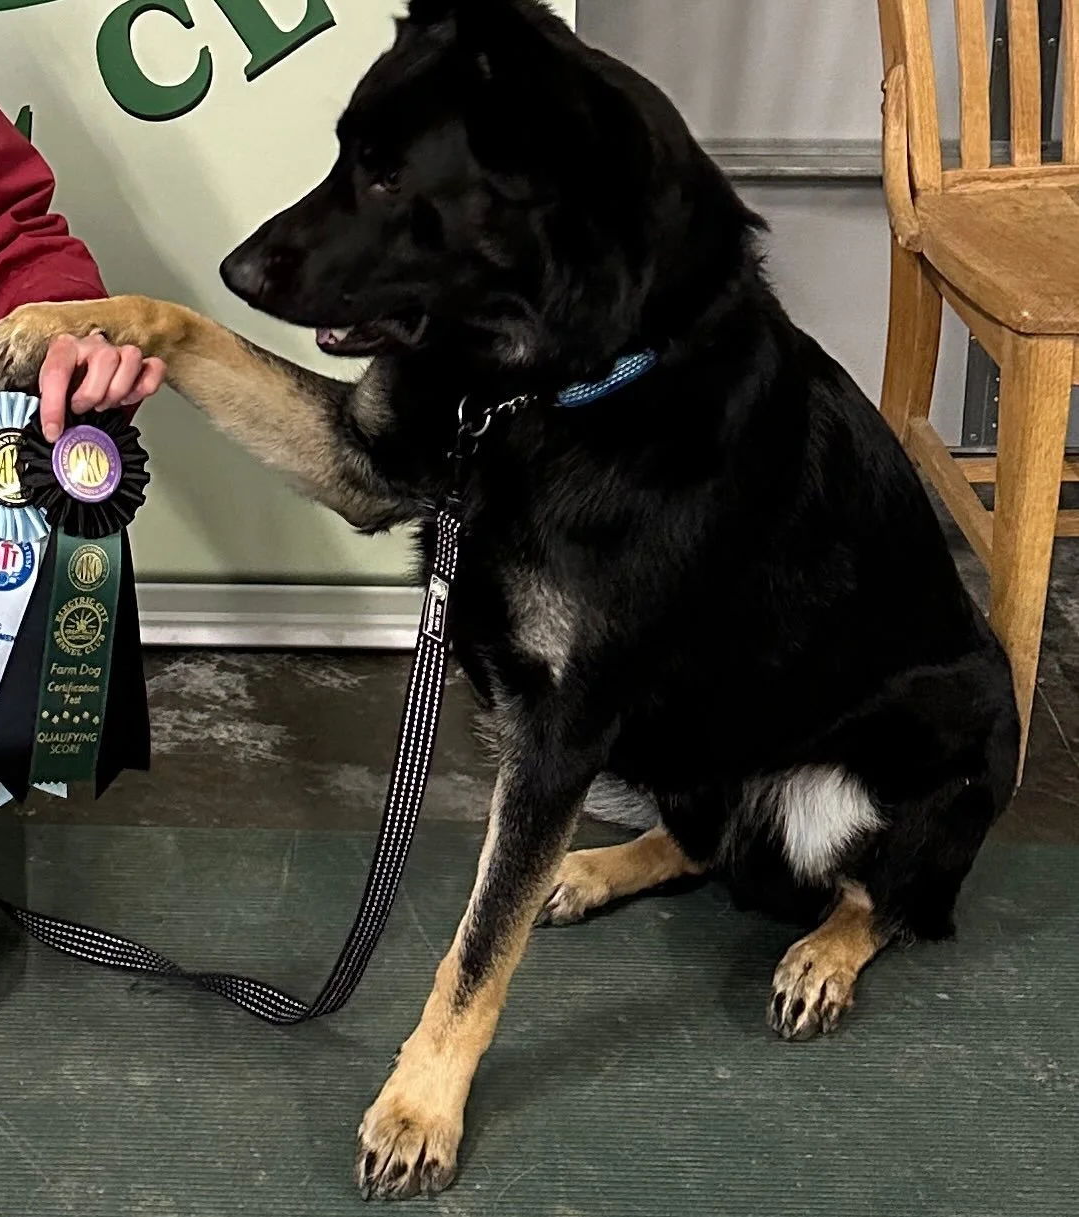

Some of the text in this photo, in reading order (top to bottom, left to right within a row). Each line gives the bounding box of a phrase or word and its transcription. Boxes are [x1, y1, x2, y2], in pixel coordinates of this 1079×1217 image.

[50, 662, 102, 678] Farm Dog
[47, 680, 100, 695] Certification
[64, 693, 82, 705] Test
[36, 731, 99, 744] QUALIFYING
[49, 744, 82, 755] SCORE
